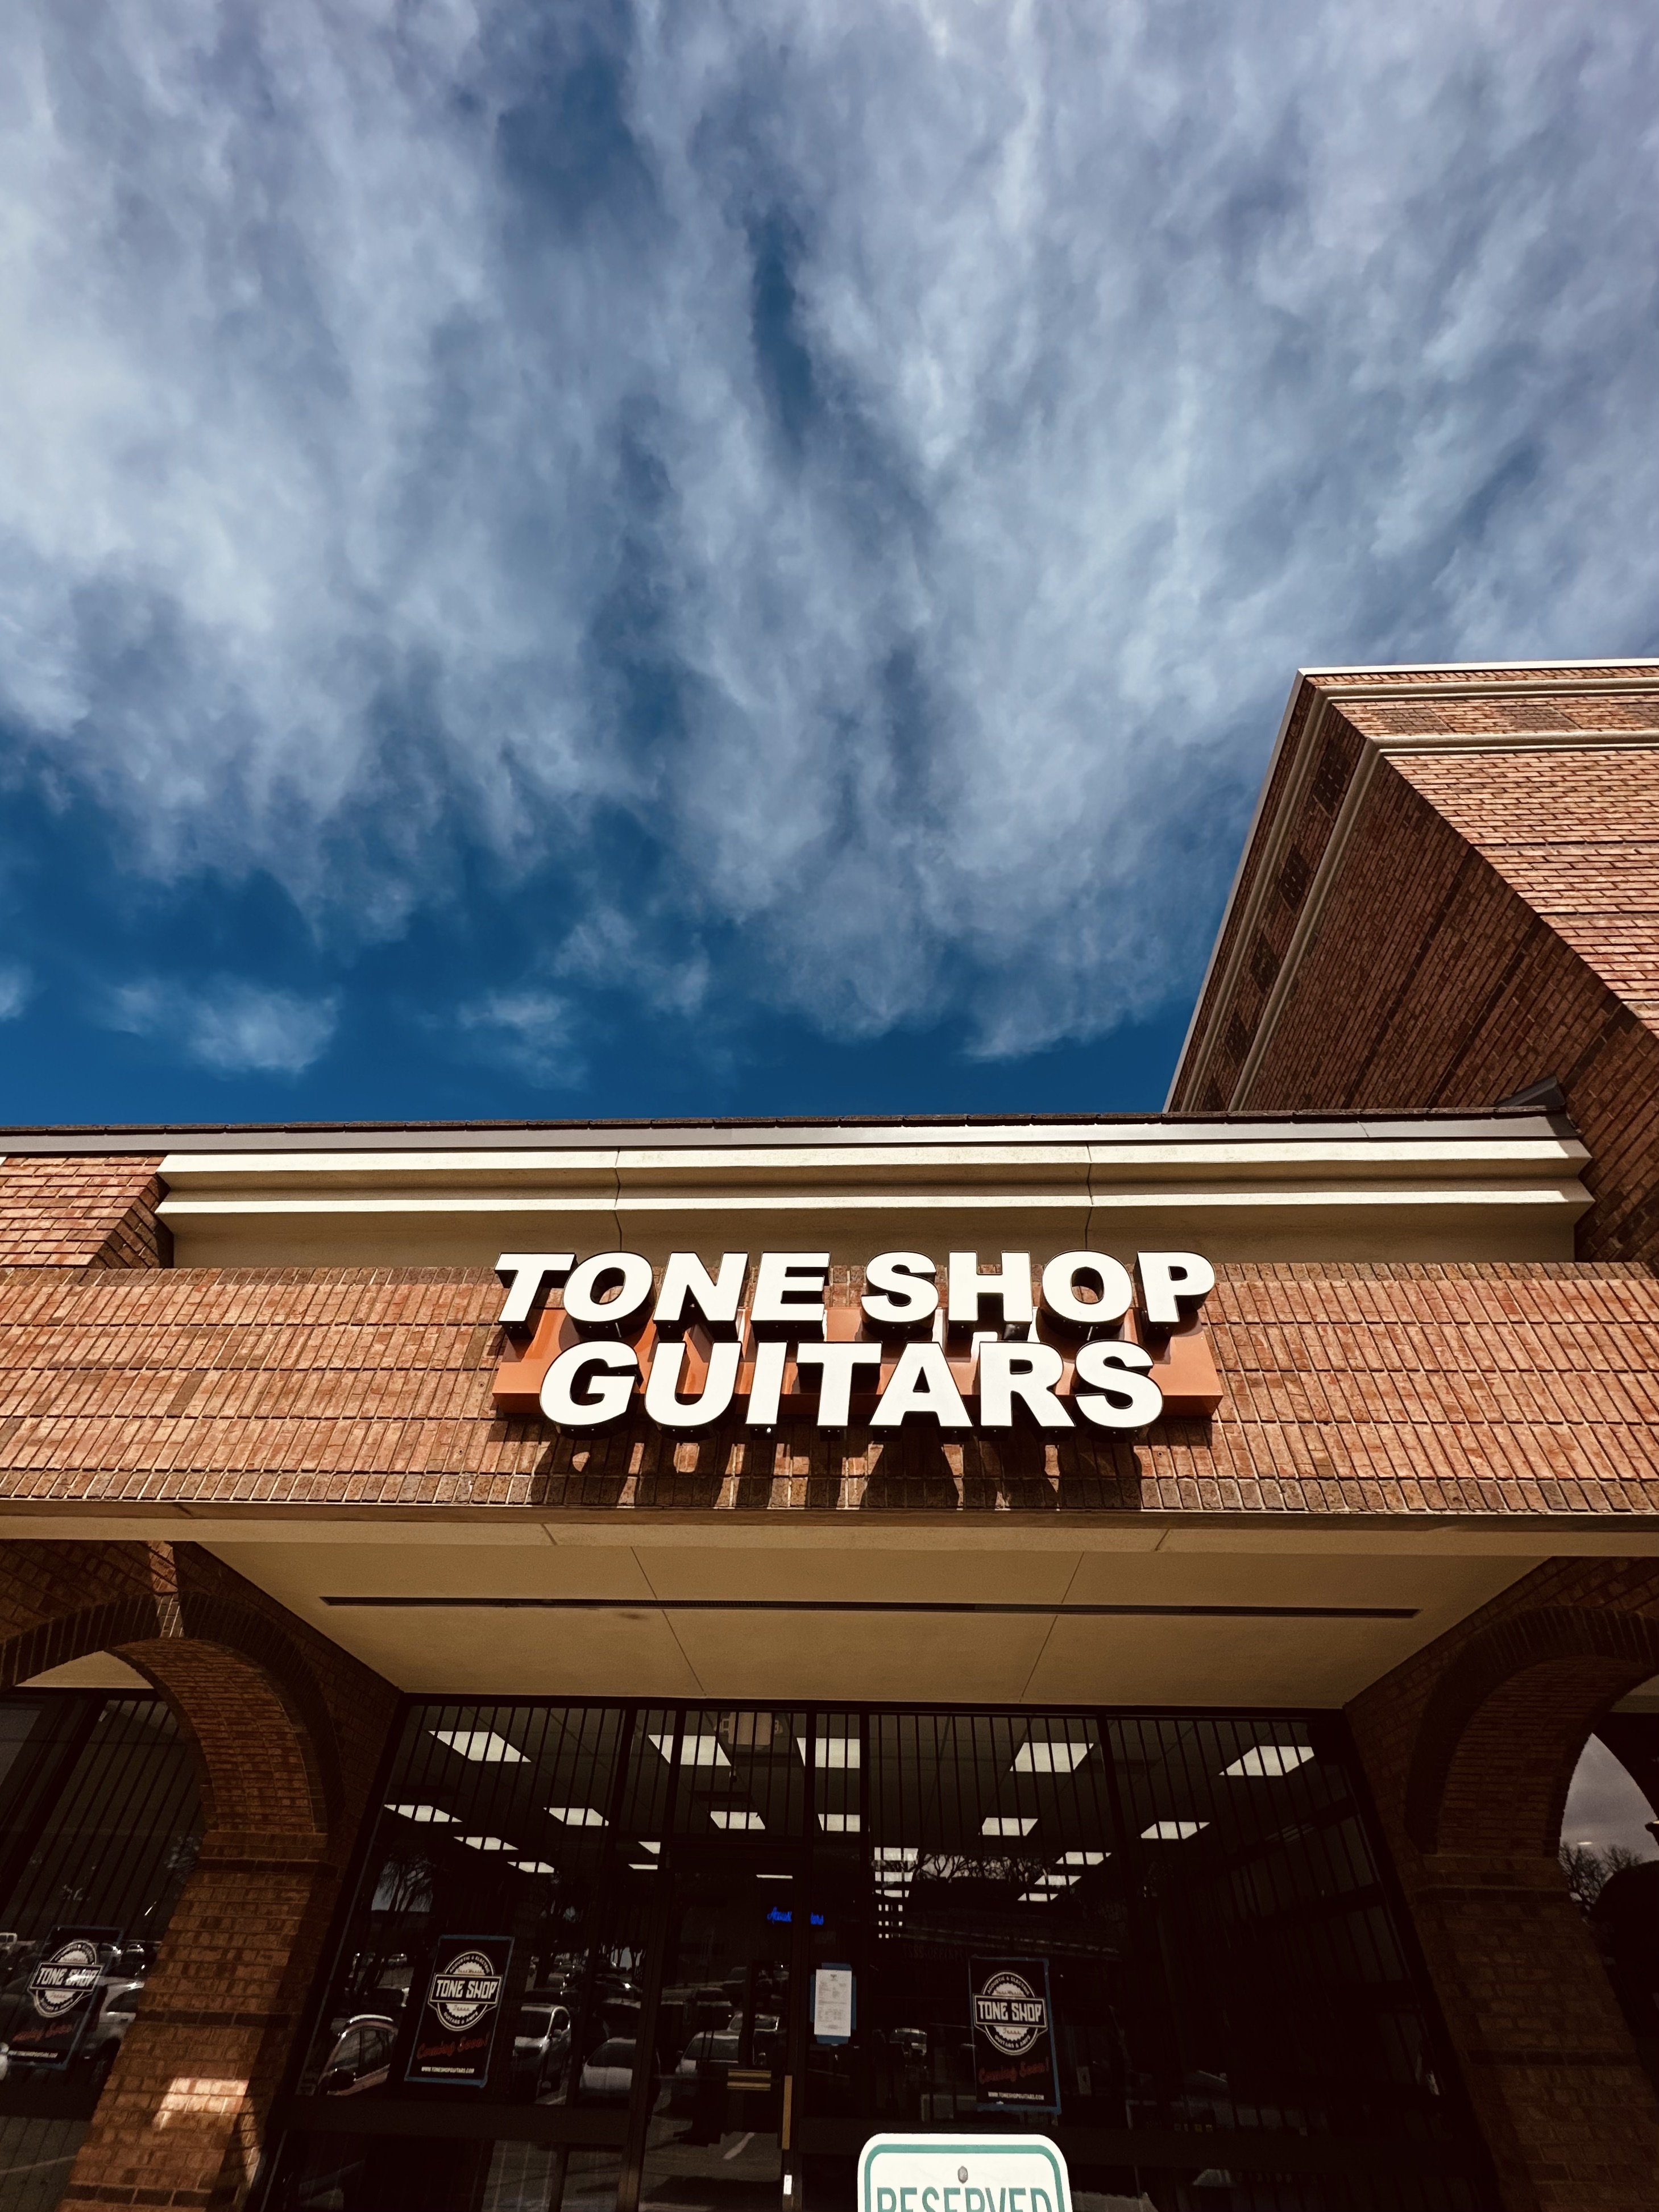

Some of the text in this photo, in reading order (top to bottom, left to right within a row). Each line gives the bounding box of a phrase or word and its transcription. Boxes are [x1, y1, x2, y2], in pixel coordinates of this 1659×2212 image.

[494, 1251, 1216, 1323] TONE SHOP
[540, 1341, 1163, 1428] GUITARS
[36, 1967, 99, 1987] TONE SHOP
[436, 1979, 498, 2000] TONE SHOP
[977, 2000, 1042, 2023] TONE SHOP
[877, 2186, 1053, 2212] RESERVED
